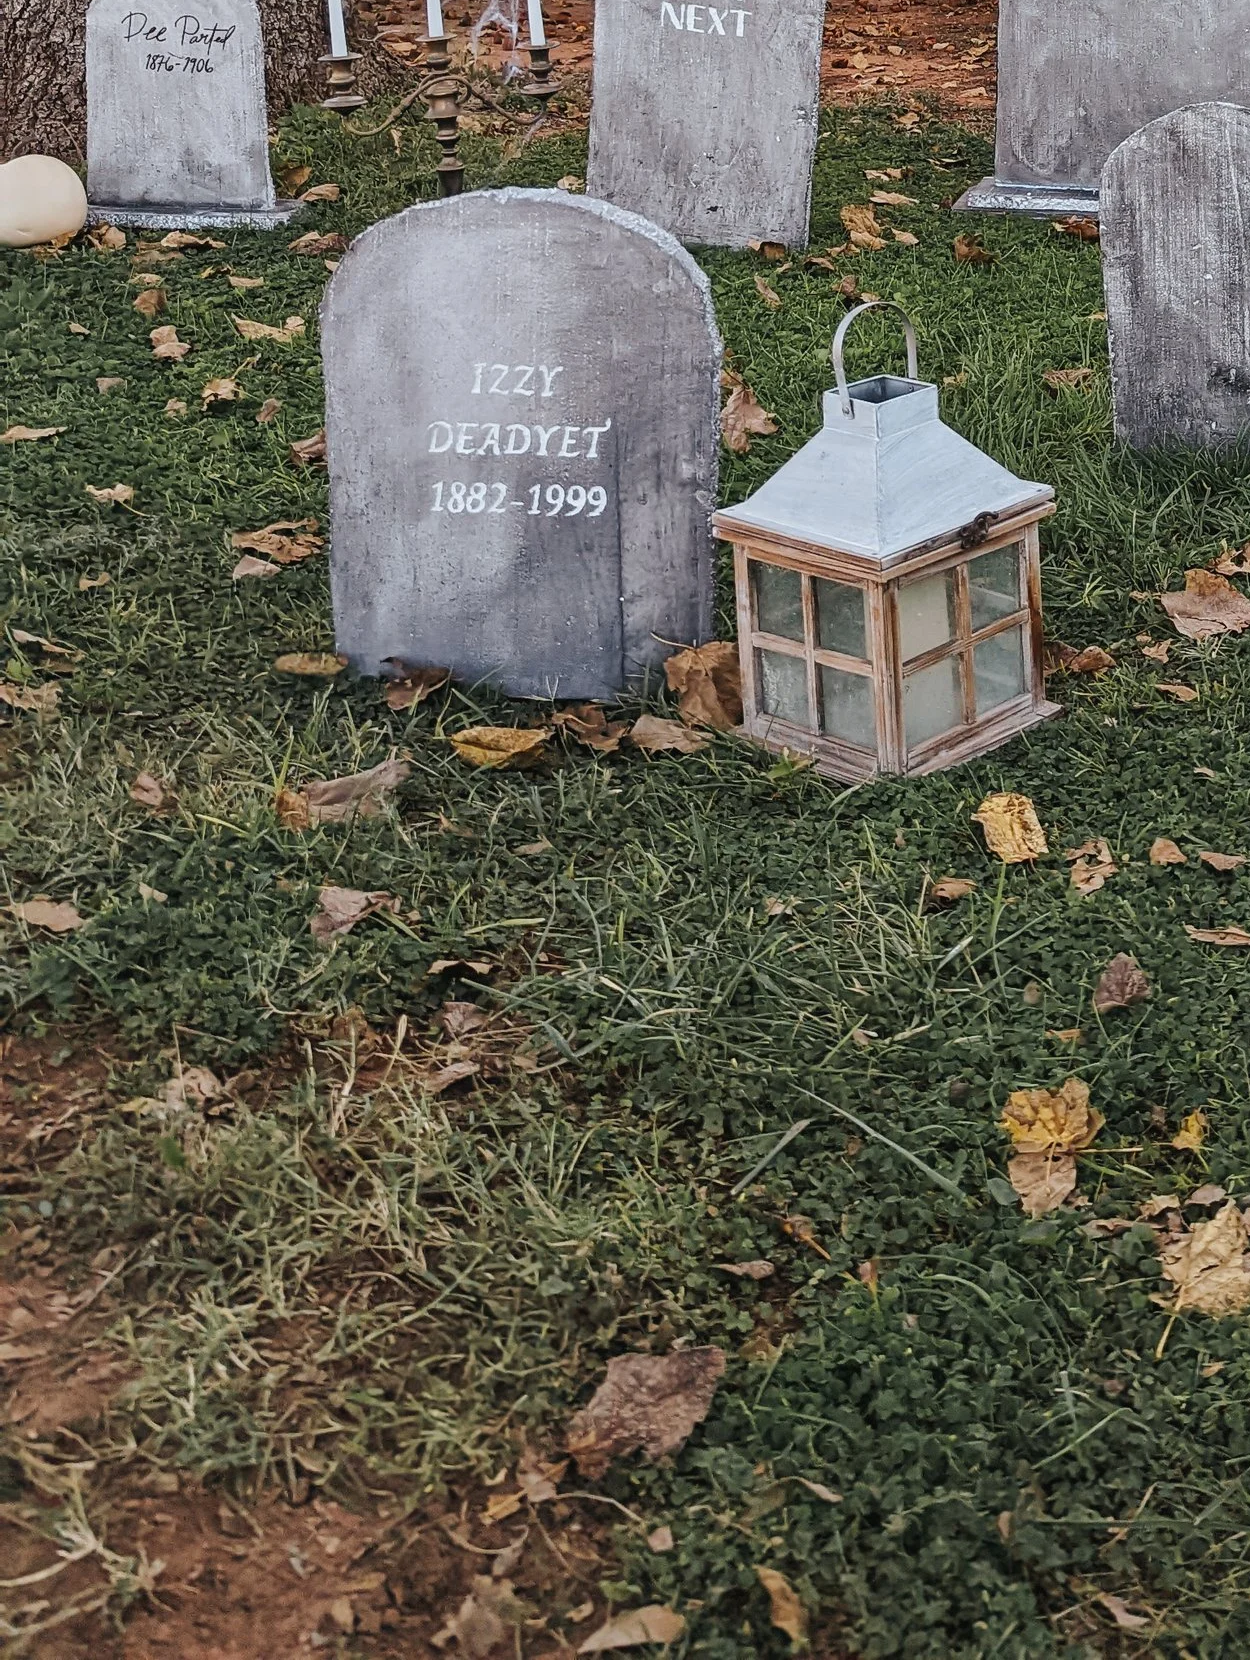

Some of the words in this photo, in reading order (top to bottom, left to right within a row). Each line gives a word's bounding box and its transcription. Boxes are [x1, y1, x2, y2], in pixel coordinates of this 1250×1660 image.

[121, 11, 167, 42] Dee
[174, 15, 236, 55] Parted
[660, 0, 753, 37] NEXT
[145, 53, 214, 73] 1876-1906
[471, 362, 564, 397] IZZY
[427, 417, 612, 458] DEADYET
[430, 480, 608, 517] 1882-1999
